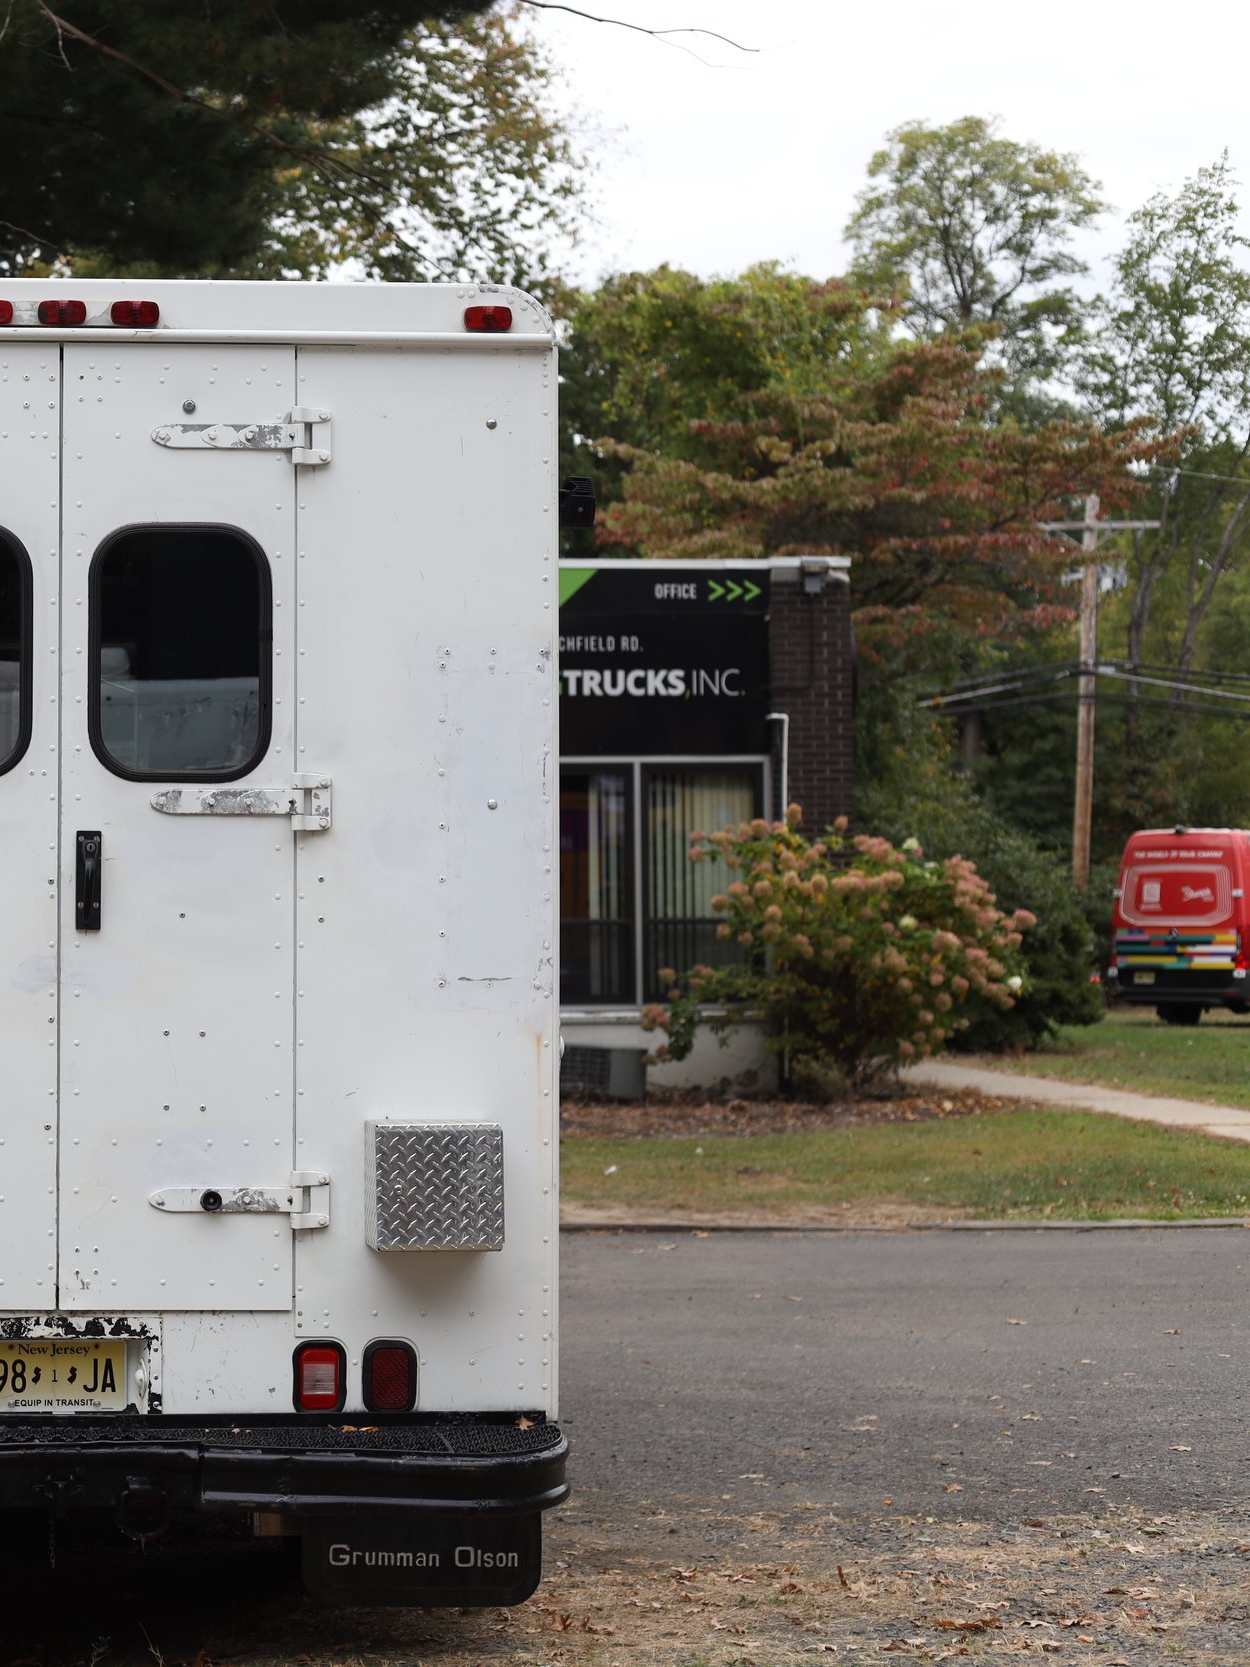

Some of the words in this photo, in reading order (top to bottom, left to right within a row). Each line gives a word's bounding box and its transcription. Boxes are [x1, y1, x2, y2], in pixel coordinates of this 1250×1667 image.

[655, 583, 697, 600] OFFICE
[621, 635, 644, 652] RD.
[18, 1343, 49, 1355] New
[50, 1343, 91, 1357] Jersey
[83, 1358, 116, 1392] JA
[14, 1399, 42, 1408] EQUIP
[44, 1399, 53, 1407] IN
[56, 1398, 94, 1407] TRANSIT
[329, 1544, 440, 1567] Grumman
[454, 1546, 519, 1567] Olson
